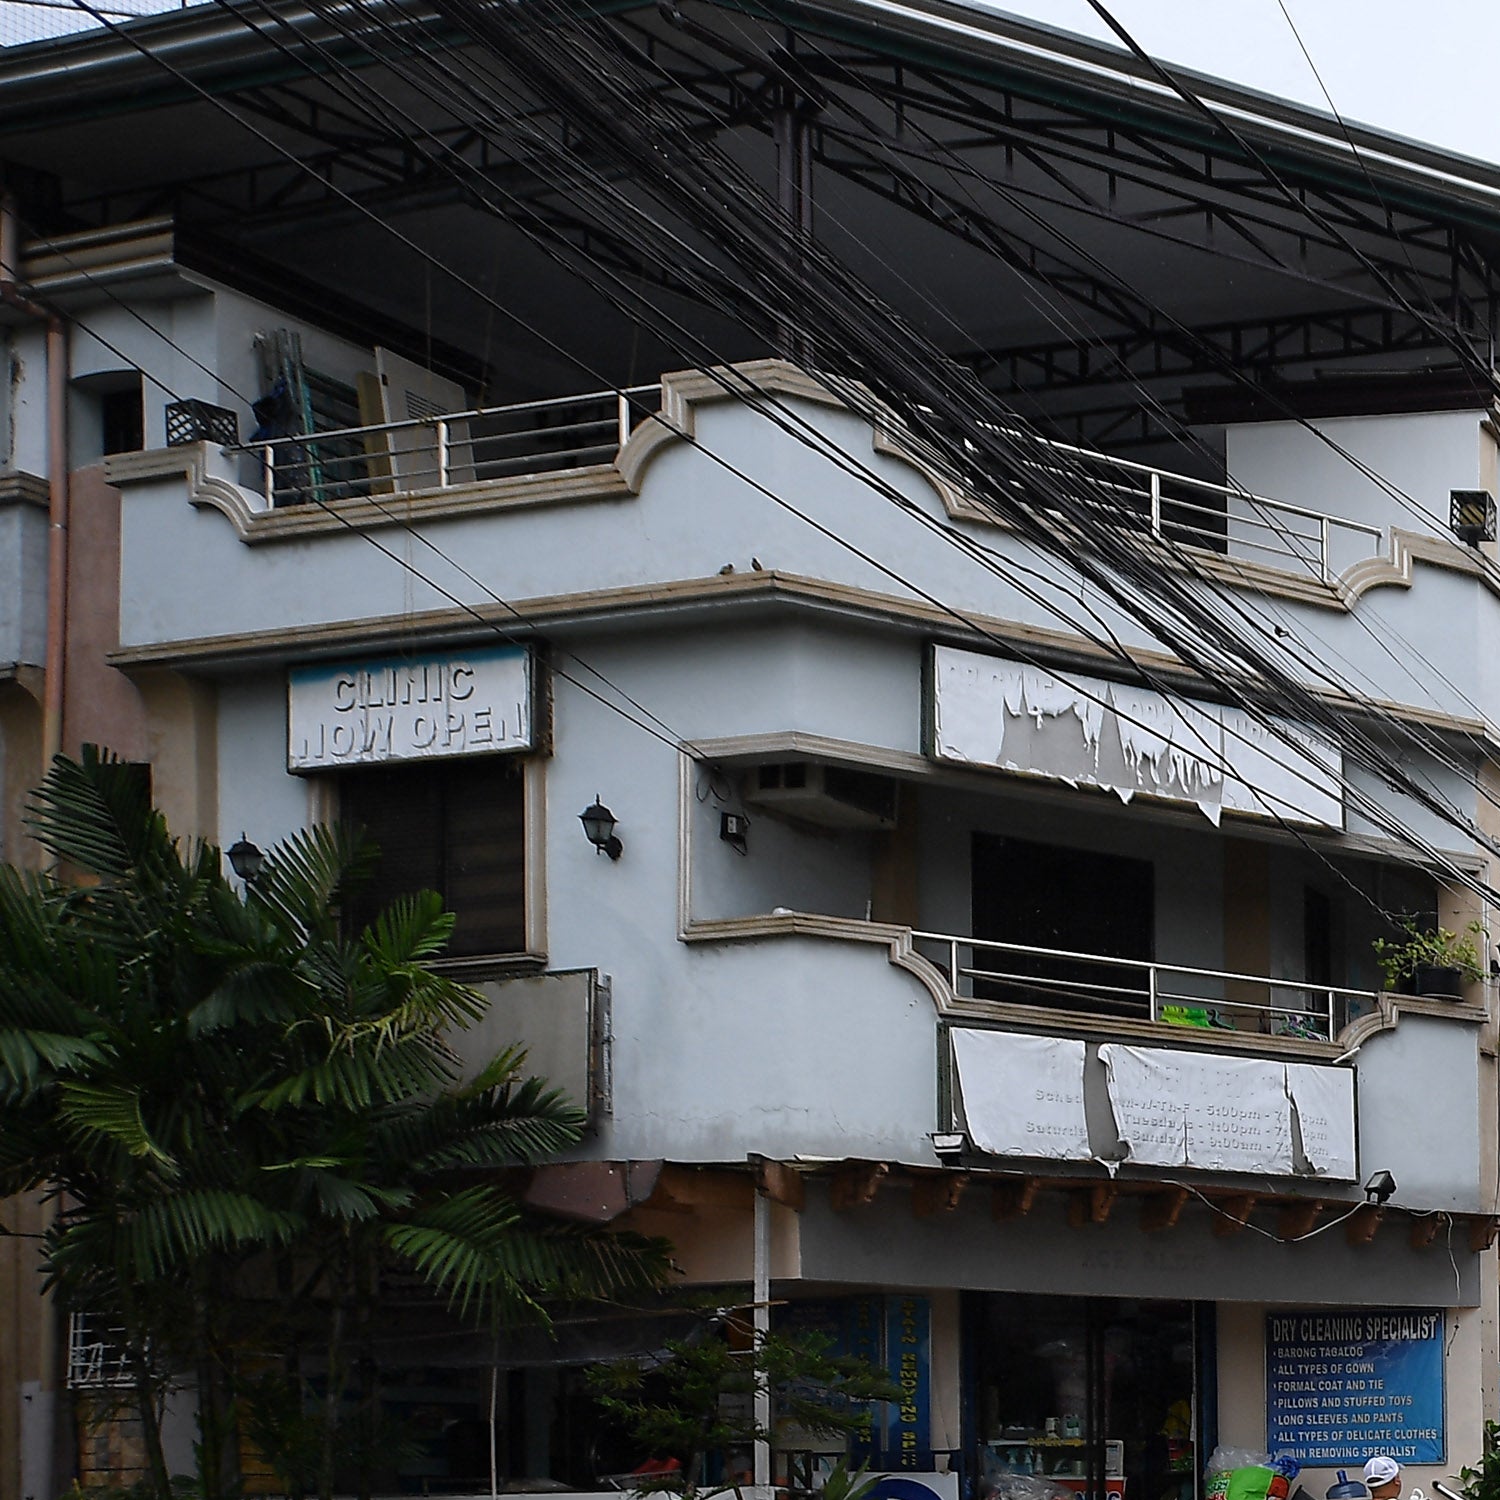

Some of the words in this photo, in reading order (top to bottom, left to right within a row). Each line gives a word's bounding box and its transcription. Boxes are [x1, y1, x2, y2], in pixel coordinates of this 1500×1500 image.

[333, 662, 475, 712] CLINIC
[299, 715, 394, 760] NOW
[410, 703, 523, 750] OPEN
[1036, 1089, 1084, 1104] Sched
[1123, 1113, 1194, 1132] Tuesdays
[1026, 1121, 1088, 1137] Saturda
[1132, 1130, 1195, 1148] Sundays
[1273, 1319, 1296, 1341] DRY
[1300, 1317, 1362, 1341] CLEANING
[1366, 1316, 1437, 1340] SPECIALIST
[1278, 1347, 1316, 1358] BARONG
[1319, 1346, 1363, 1357] TAGALOG
[1278, 1364, 1295, 1375] ALL
[1298, 1364, 1328, 1374] TYPES
[1330, 1363, 1342, 1373] OF
[1345, 1363, 1374, 1373] GOWN
[1278, 1381, 1316, 1391] FORMAL
[1318, 1380, 1343, 1391] COAT
[1346, 1380, 1366, 1390] AND
[1369, 1379, 1384, 1389] TIE
[1278, 1398, 1318, 1408] PILLOWS
[1321, 1397, 1341, 1408] AND
[1343, 1396, 1385, 1407] STUFFED
[1388, 1396, 1412, 1406] TOYS
[1278, 1415, 1304, 1426] LONG
[1306, 1414, 1348, 1425] SLEEVES
[1351, 1413, 1370, 1424] AND
[1373, 1412, 1404, 1423] PANTS
[1278, 1431, 1295, 1442] ALL
[1298, 1431, 1329, 1442] TYPES
[1331, 1430, 1344, 1441] OF
[1346, 1430, 1391, 1441] DELICATE
[1394, 1429, 1437, 1439] CLOTHES
[1309, 1447, 1359, 1458] REMOVING
[1362, 1446, 1416, 1457] SPECIALIST
